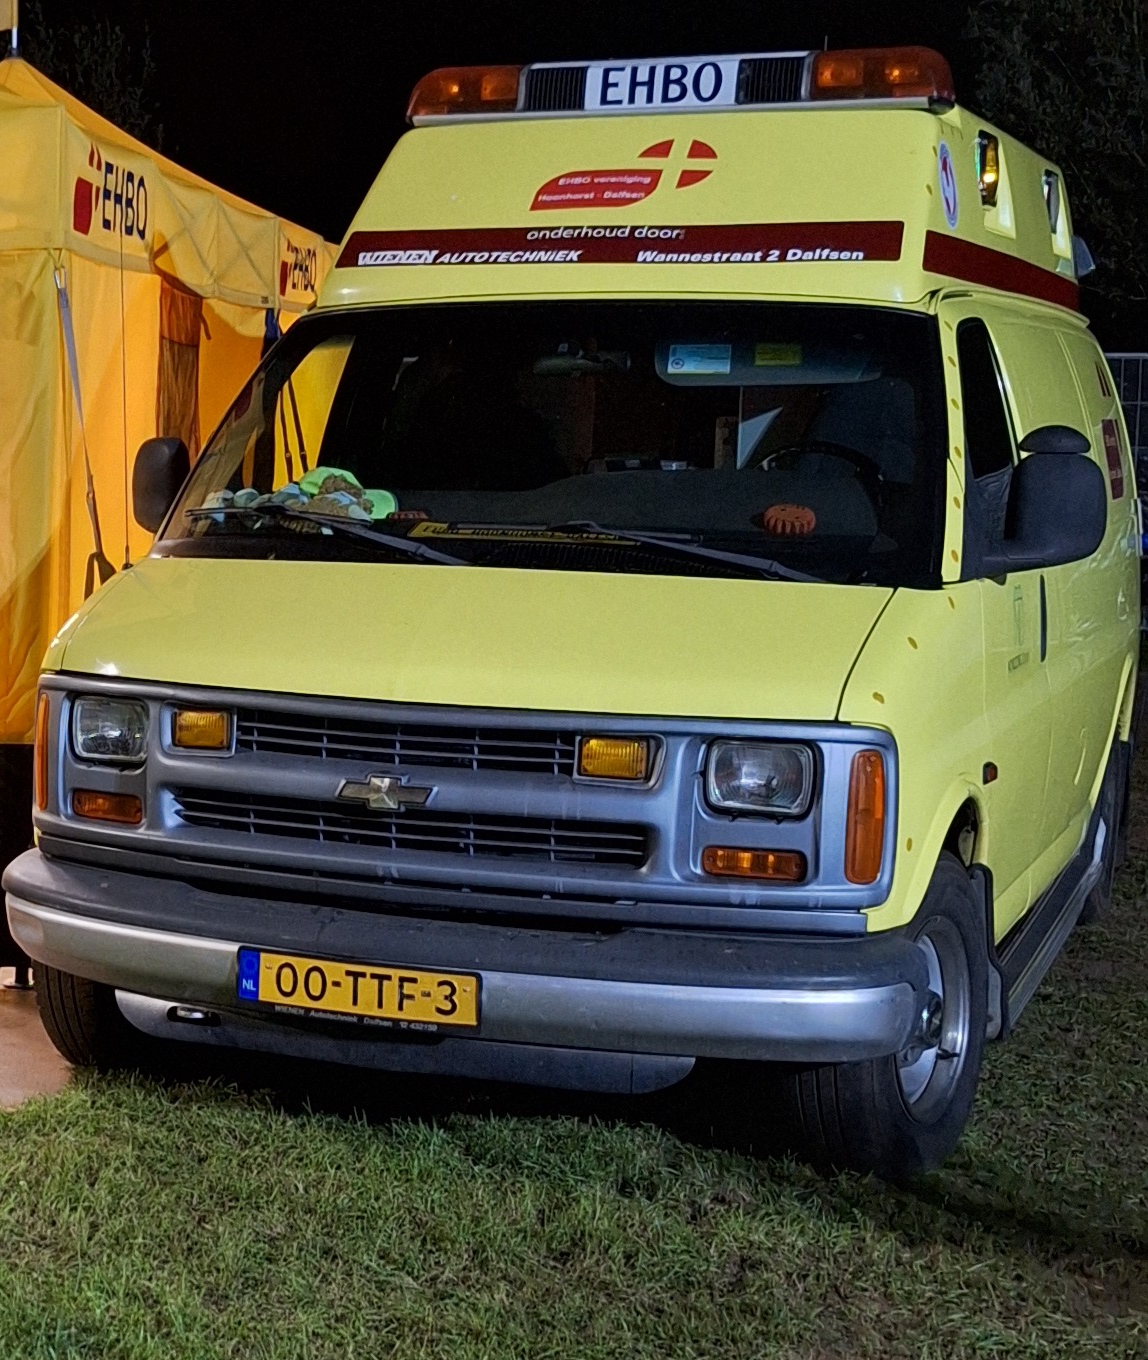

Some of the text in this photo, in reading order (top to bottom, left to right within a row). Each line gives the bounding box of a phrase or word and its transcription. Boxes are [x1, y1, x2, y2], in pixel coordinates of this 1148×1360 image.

[600, 62, 723, 106] EHBO
[558, 174, 651, 186] EHBO vereniging
[102, 160, 148, 240] EHBO
[603, 190, 646, 200] Dalfsen
[526, 225, 631, 240] onderhoud
[357, 250, 583, 266] WIENEN AUTOTECHNIEK
[636, 248, 865, 263] Wannestraat 2 Dalfsen
[292, 246, 317, 292] EHBO
[242, 979, 257, 991] NL
[275, 961, 458, 1017] 00-TTF-3
